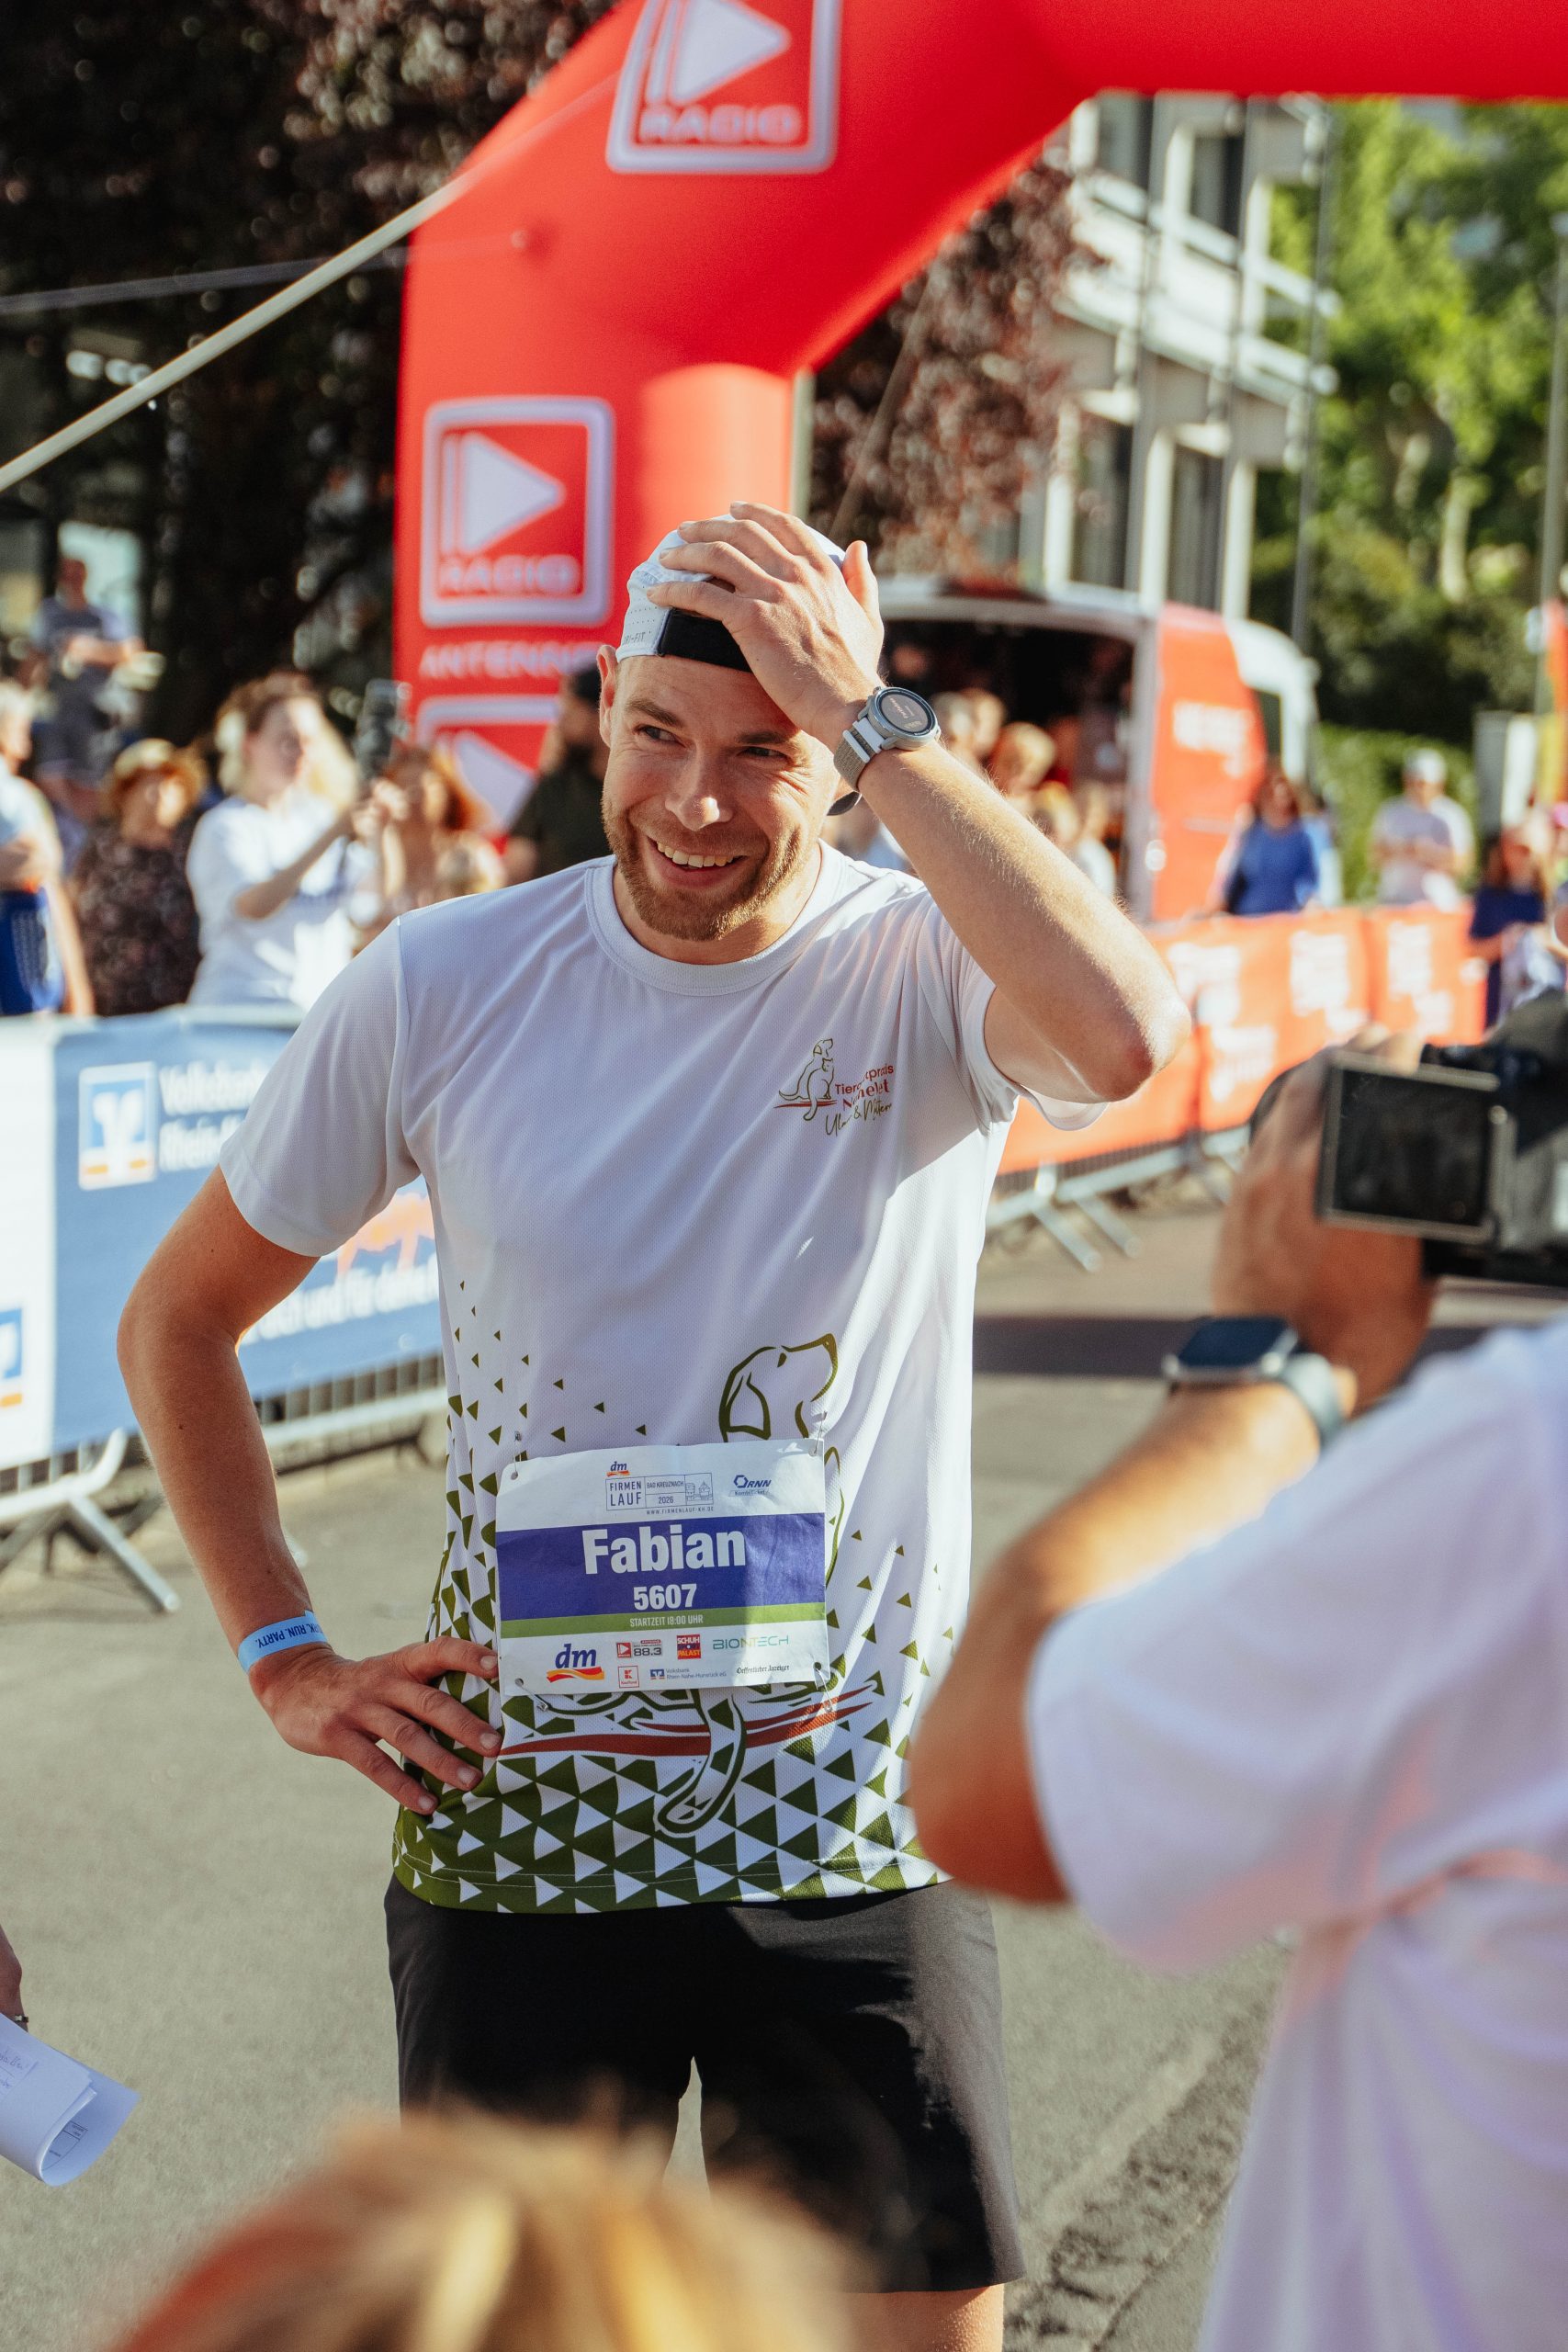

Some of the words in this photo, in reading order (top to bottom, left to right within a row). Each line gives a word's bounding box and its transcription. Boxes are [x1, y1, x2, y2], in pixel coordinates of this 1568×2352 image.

[610, 1461, 627, 1472] dm
[610, 1481, 642, 1491] FIRMEN
[610, 1492, 642, 1507] LAUF
[581, 1524, 746, 1575] Fabian
[633, 1584, 697, 1611] 5607
[629, 1617, 665, 1627] STARTZEIT
[667, 1615, 686, 1625] 18:00
[688, 1614, 704, 1624] UHR
[285, 1624, 306, 1637] RUN.
[254, 1630, 286, 1648] PARTY.
[677, 1636, 700, 1645] SCHUH
[555, 1643, 597, 1669] dm
[634, 1647, 661, 1657] 88.3
